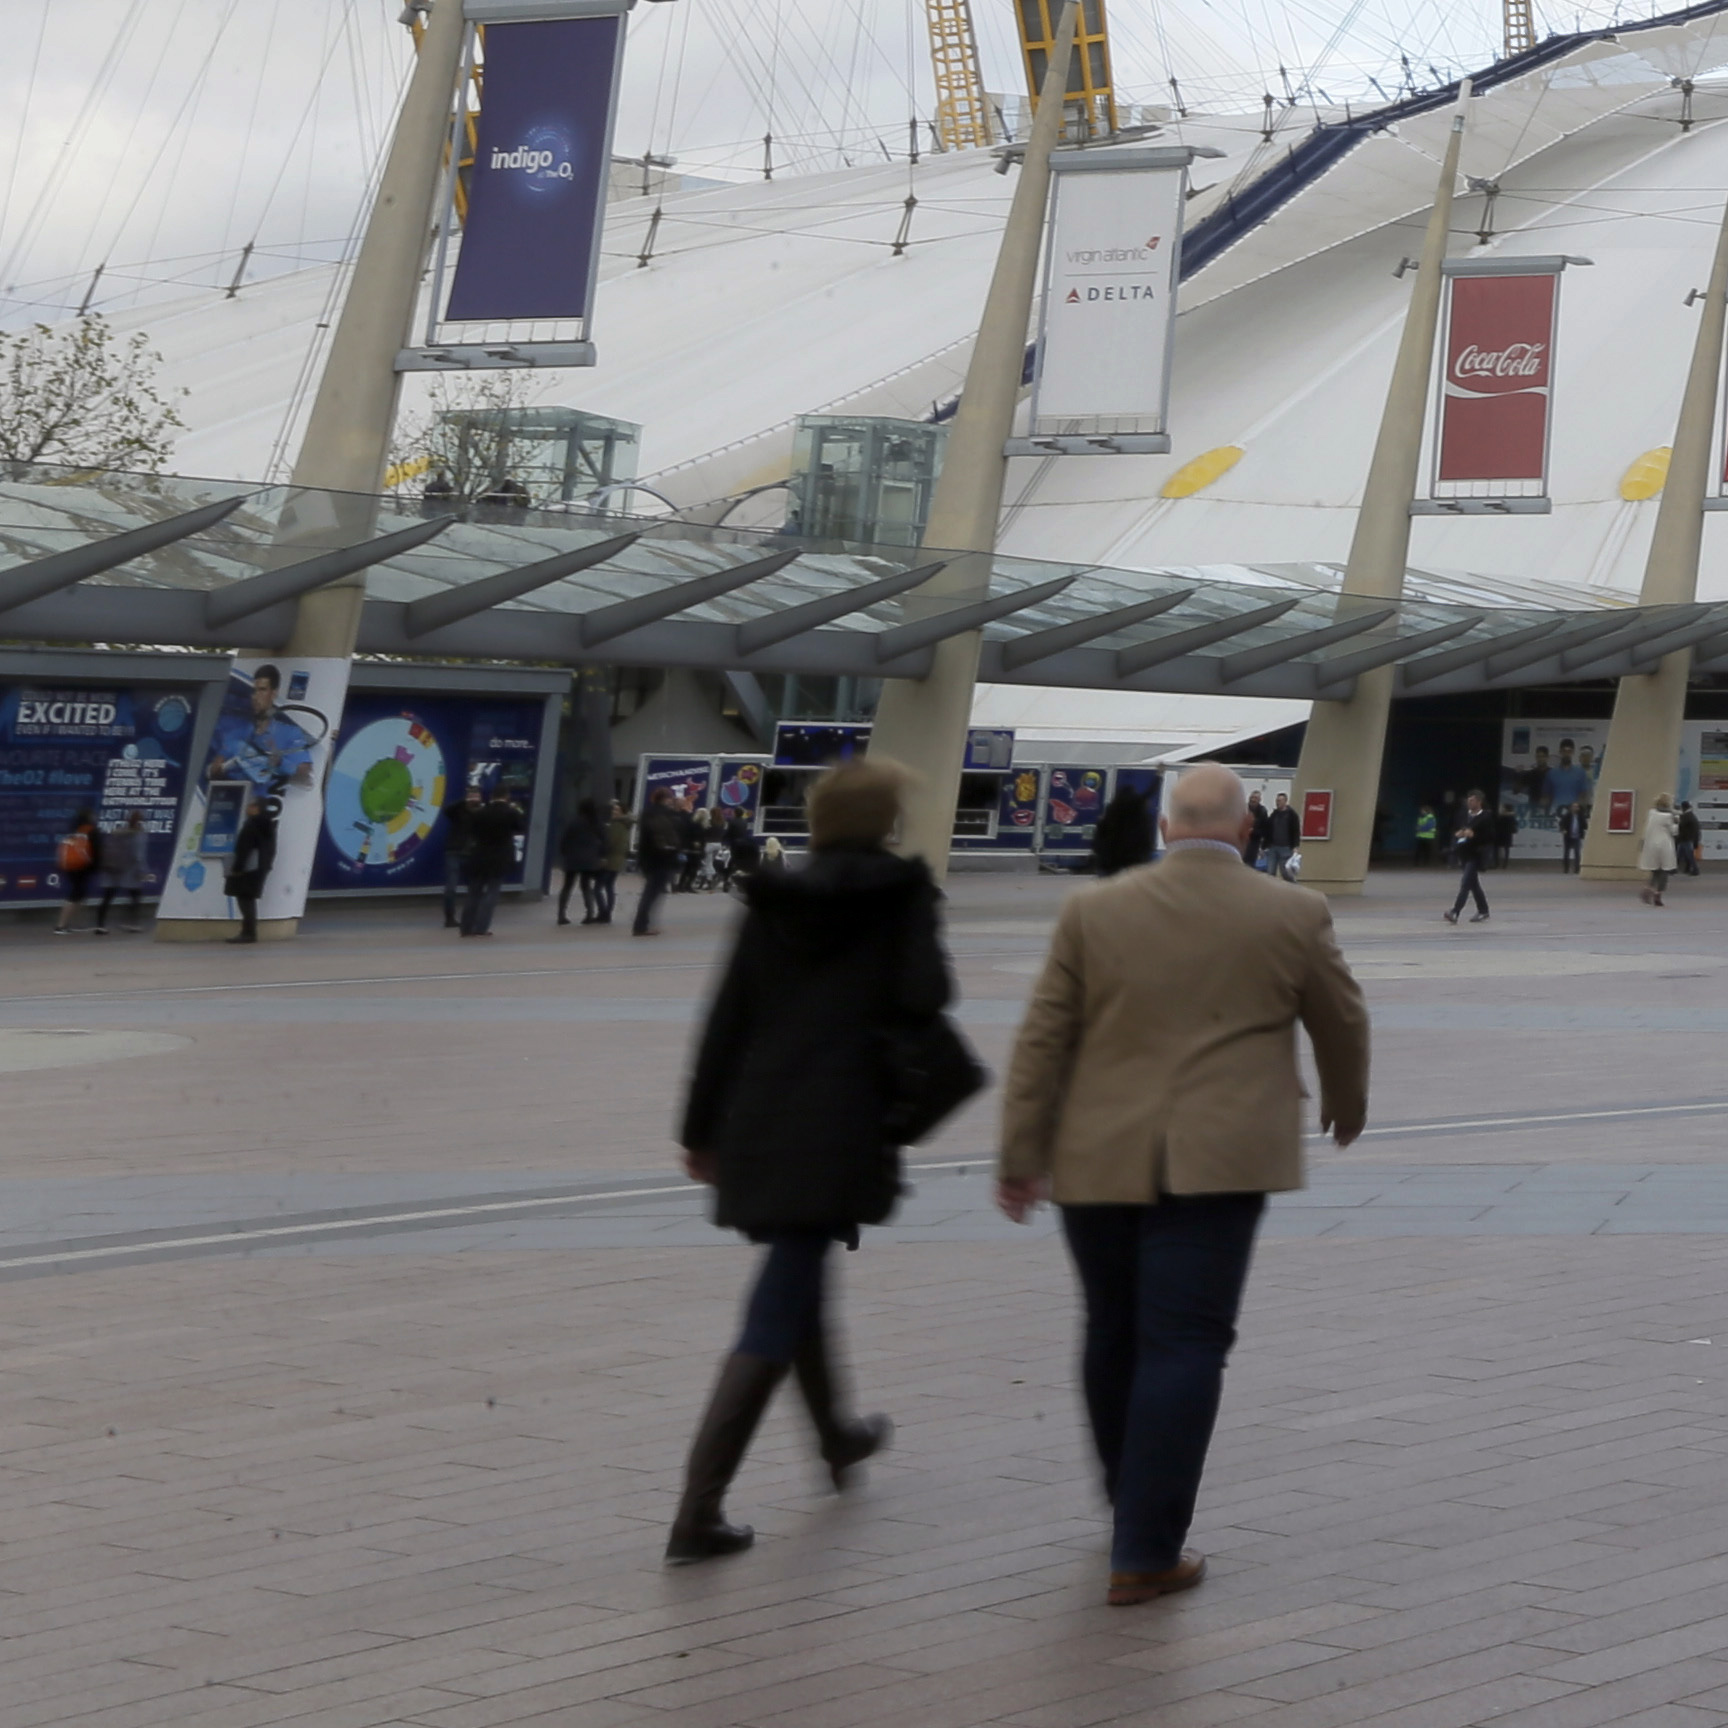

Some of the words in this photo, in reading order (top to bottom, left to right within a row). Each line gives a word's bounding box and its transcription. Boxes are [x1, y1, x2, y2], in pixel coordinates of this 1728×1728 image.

[490, 145, 554, 174] indigo
[1087, 285, 1154, 301] DELTA
[1455, 343, 1546, 378] Coca-Cola
[17, 702, 117, 724] EXCITED
[489, 737, 503, 749] do
